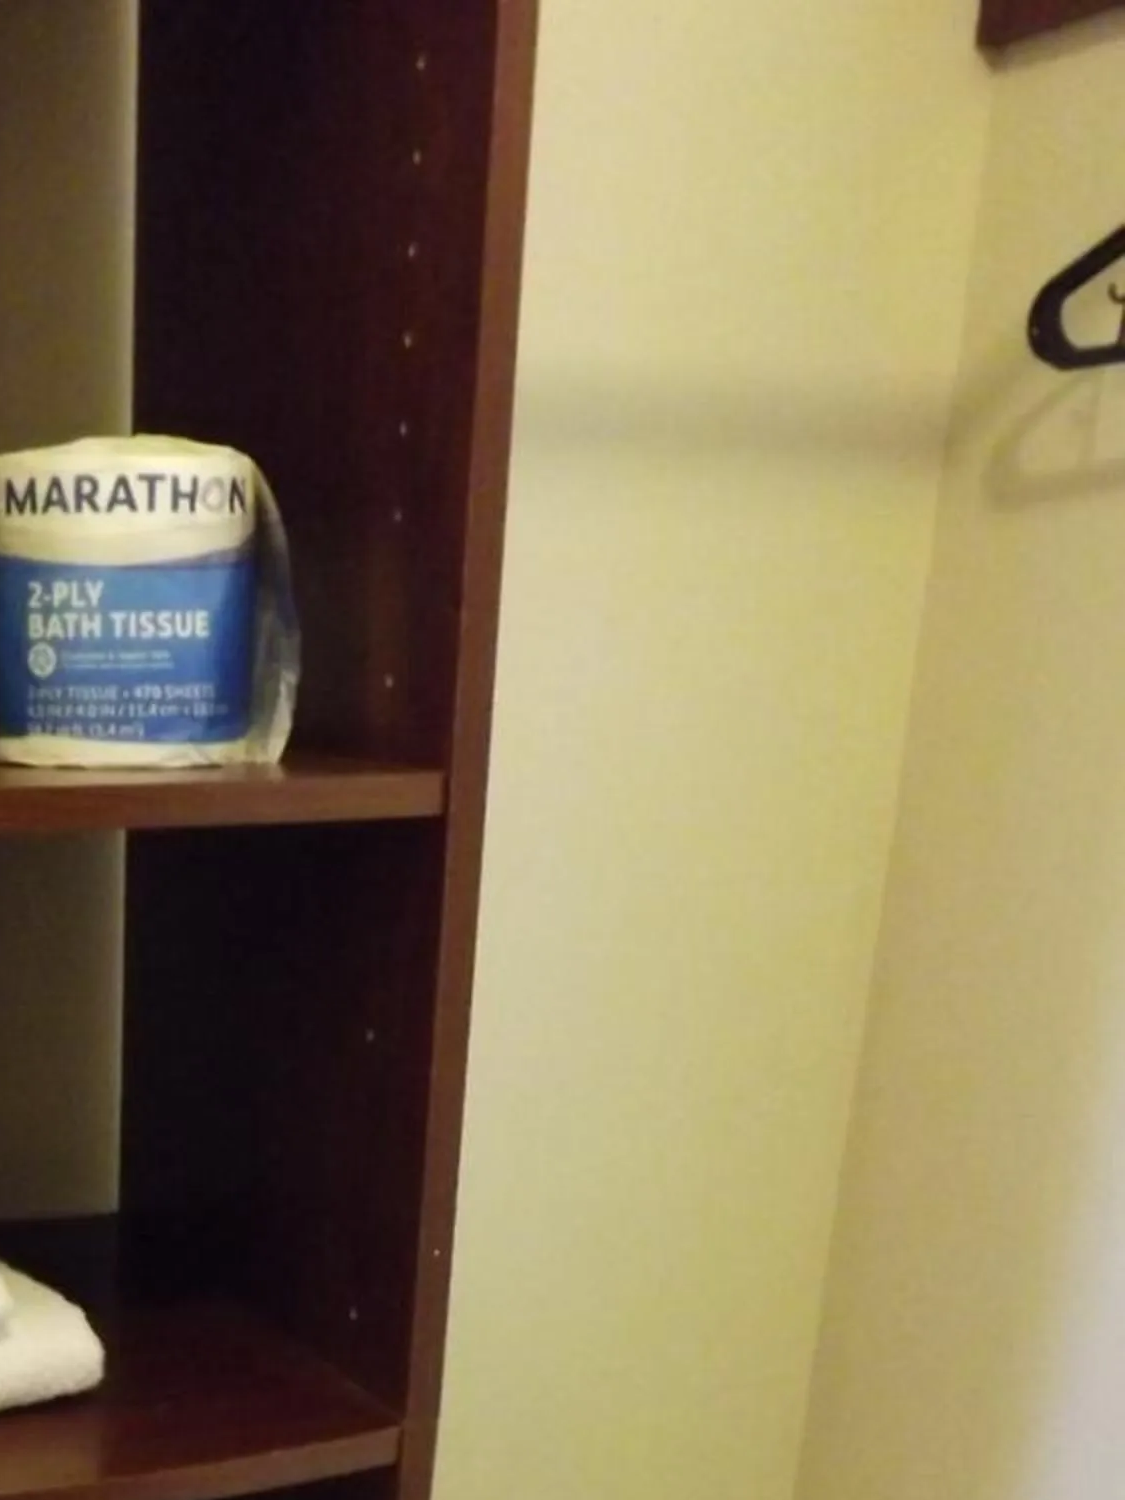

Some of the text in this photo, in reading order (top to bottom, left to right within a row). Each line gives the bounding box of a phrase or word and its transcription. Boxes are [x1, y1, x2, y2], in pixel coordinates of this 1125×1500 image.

[4, 473, 248, 516] MARATHON
[27, 579, 104, 609] 2-PLY
[28, 609, 211, 640] BATH TISSUE
